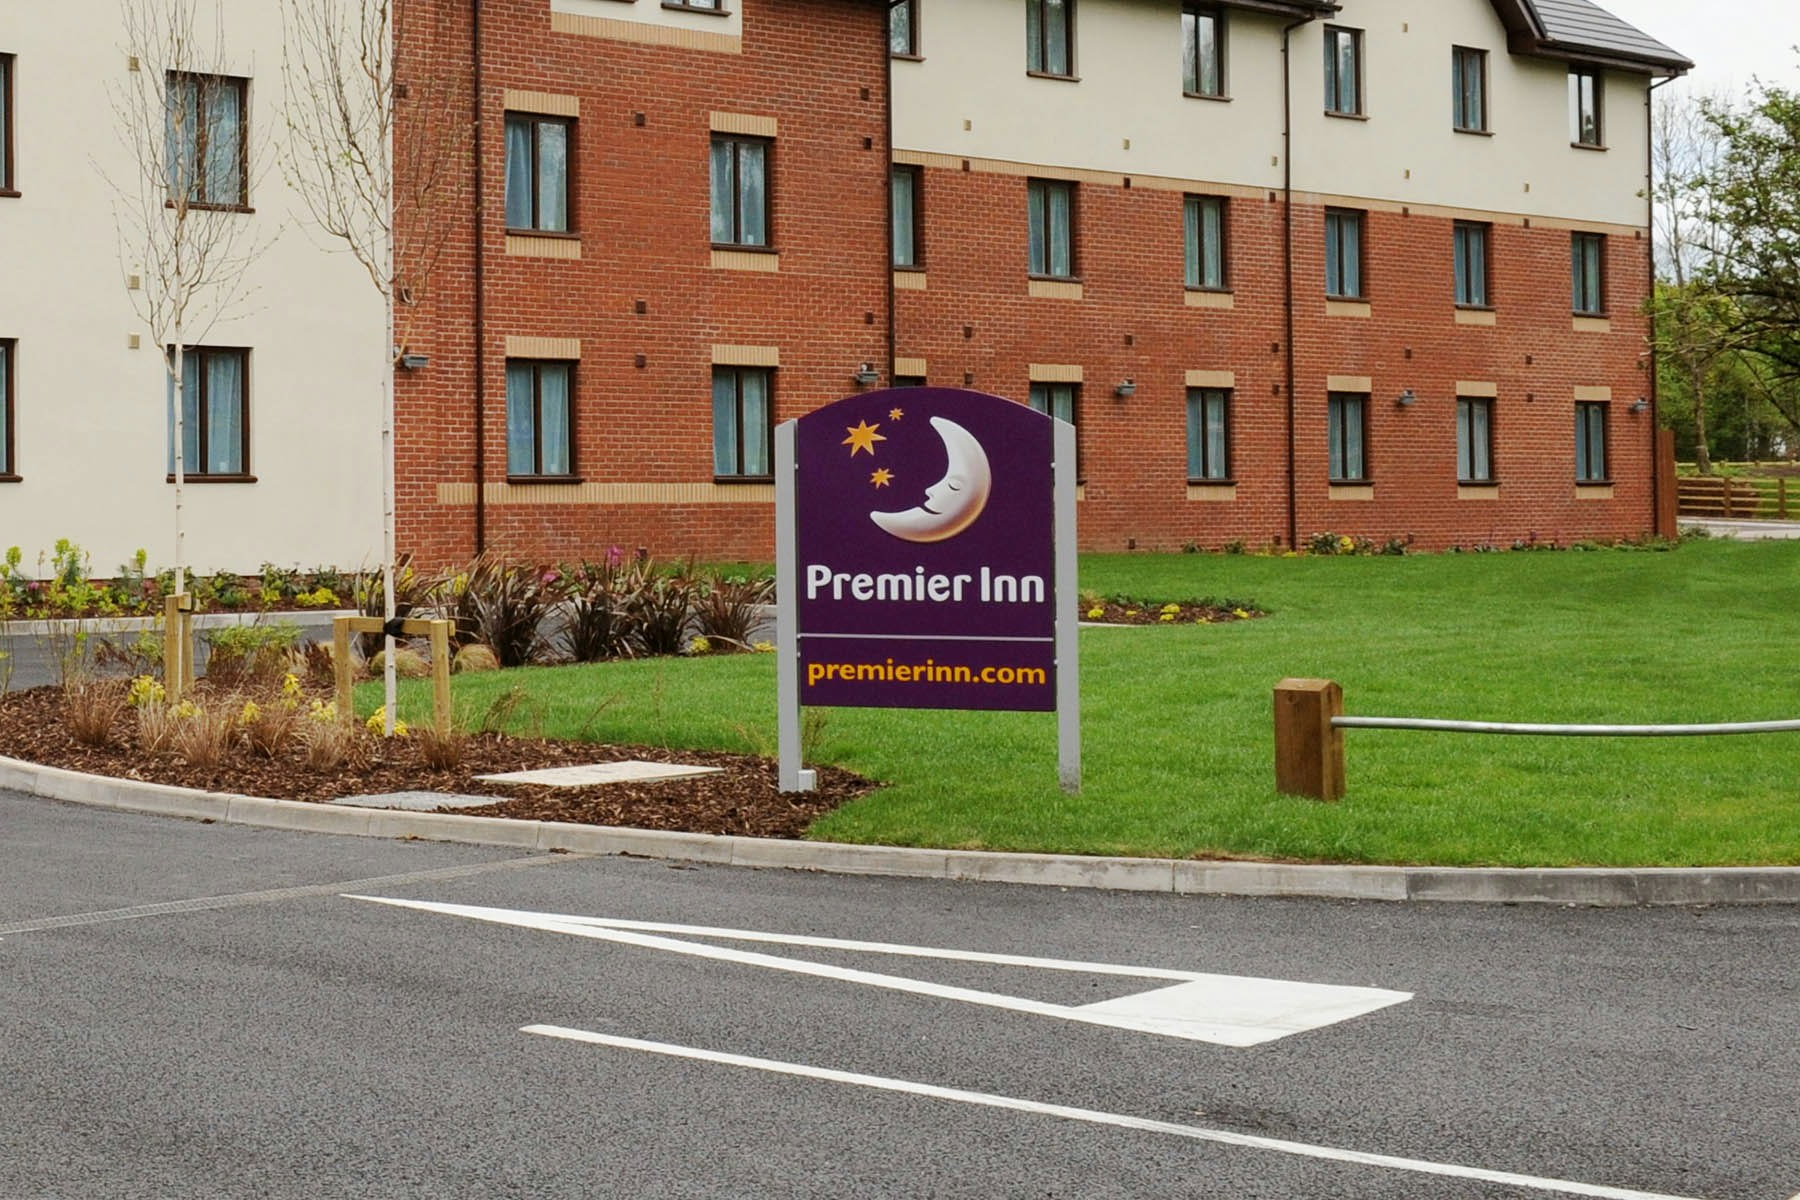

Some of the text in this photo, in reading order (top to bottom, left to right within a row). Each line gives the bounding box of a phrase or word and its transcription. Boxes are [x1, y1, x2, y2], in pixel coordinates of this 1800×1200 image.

[806, 564, 1045, 604] Premier Inn
[807, 658, 1046, 686] premierinn.com
